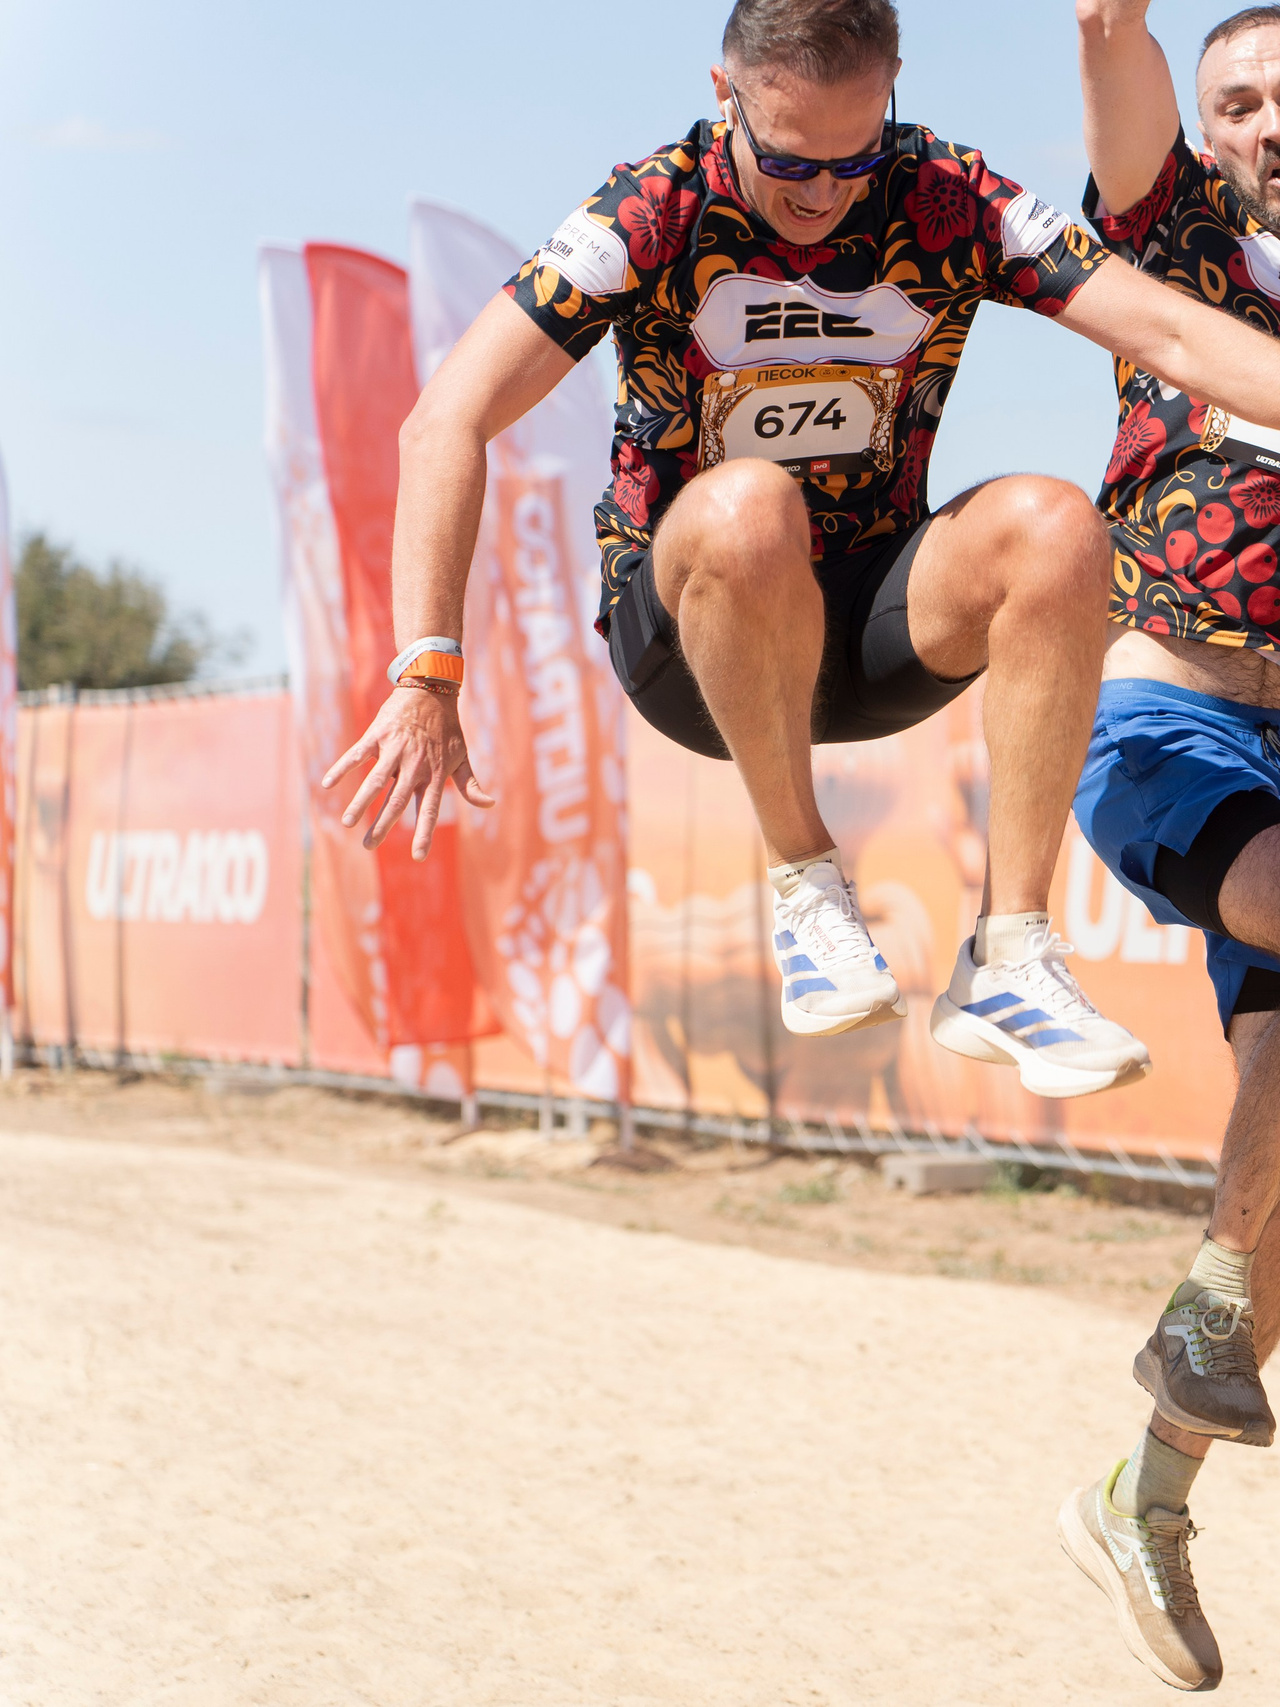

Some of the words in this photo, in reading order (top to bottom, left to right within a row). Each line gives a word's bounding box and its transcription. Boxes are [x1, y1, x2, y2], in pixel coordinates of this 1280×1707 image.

[554, 240, 574, 257] STAR
[562, 223, 612, 264] PREME
[757, 367, 817, 382] ПЕСОК
[754, 397, 847, 439] 674
[86, 829, 269, 925] ULTRA100
[785, 858, 833, 878] KIPN
[813, 924, 836, 952] ADIZERO
